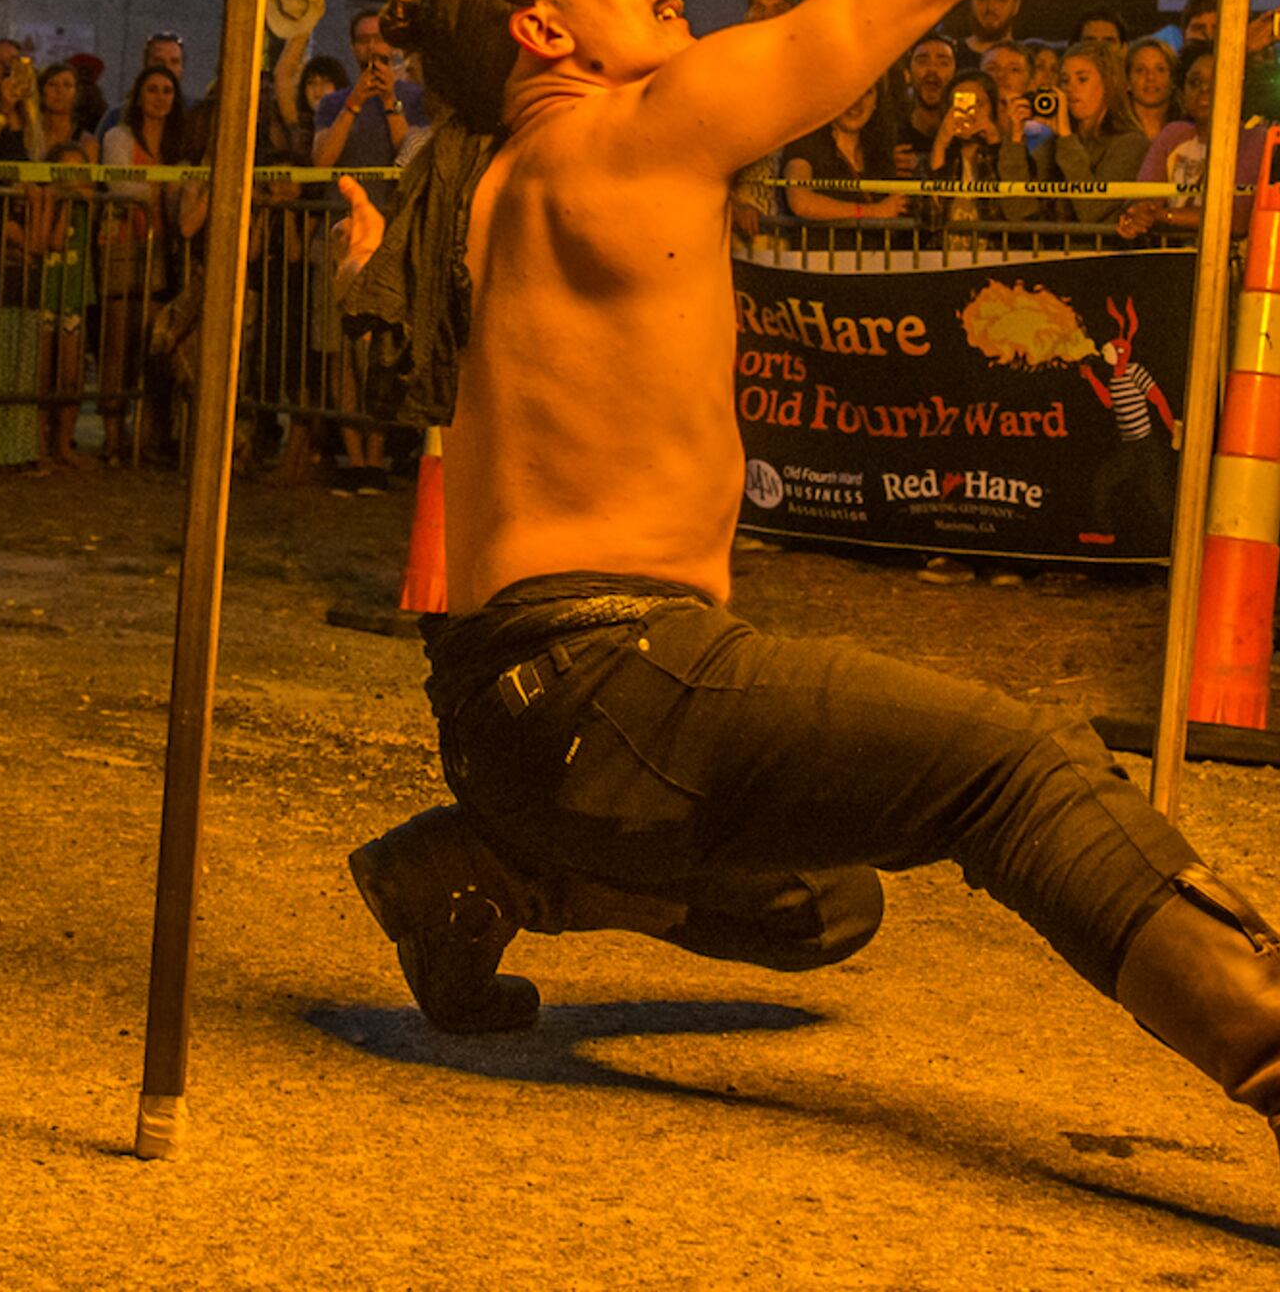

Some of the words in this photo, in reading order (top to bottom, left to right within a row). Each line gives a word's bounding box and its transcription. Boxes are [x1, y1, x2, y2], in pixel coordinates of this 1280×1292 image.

[740, 350, 807, 383] orts
[740, 386, 802, 427] Old
[810, 384, 960, 438] Fourth
[963, 402, 1068, 437] Ward
[784, 483, 864, 505] BUSINESS
[881, 468, 940, 502] Red
[964, 470, 1043, 509] Hare
